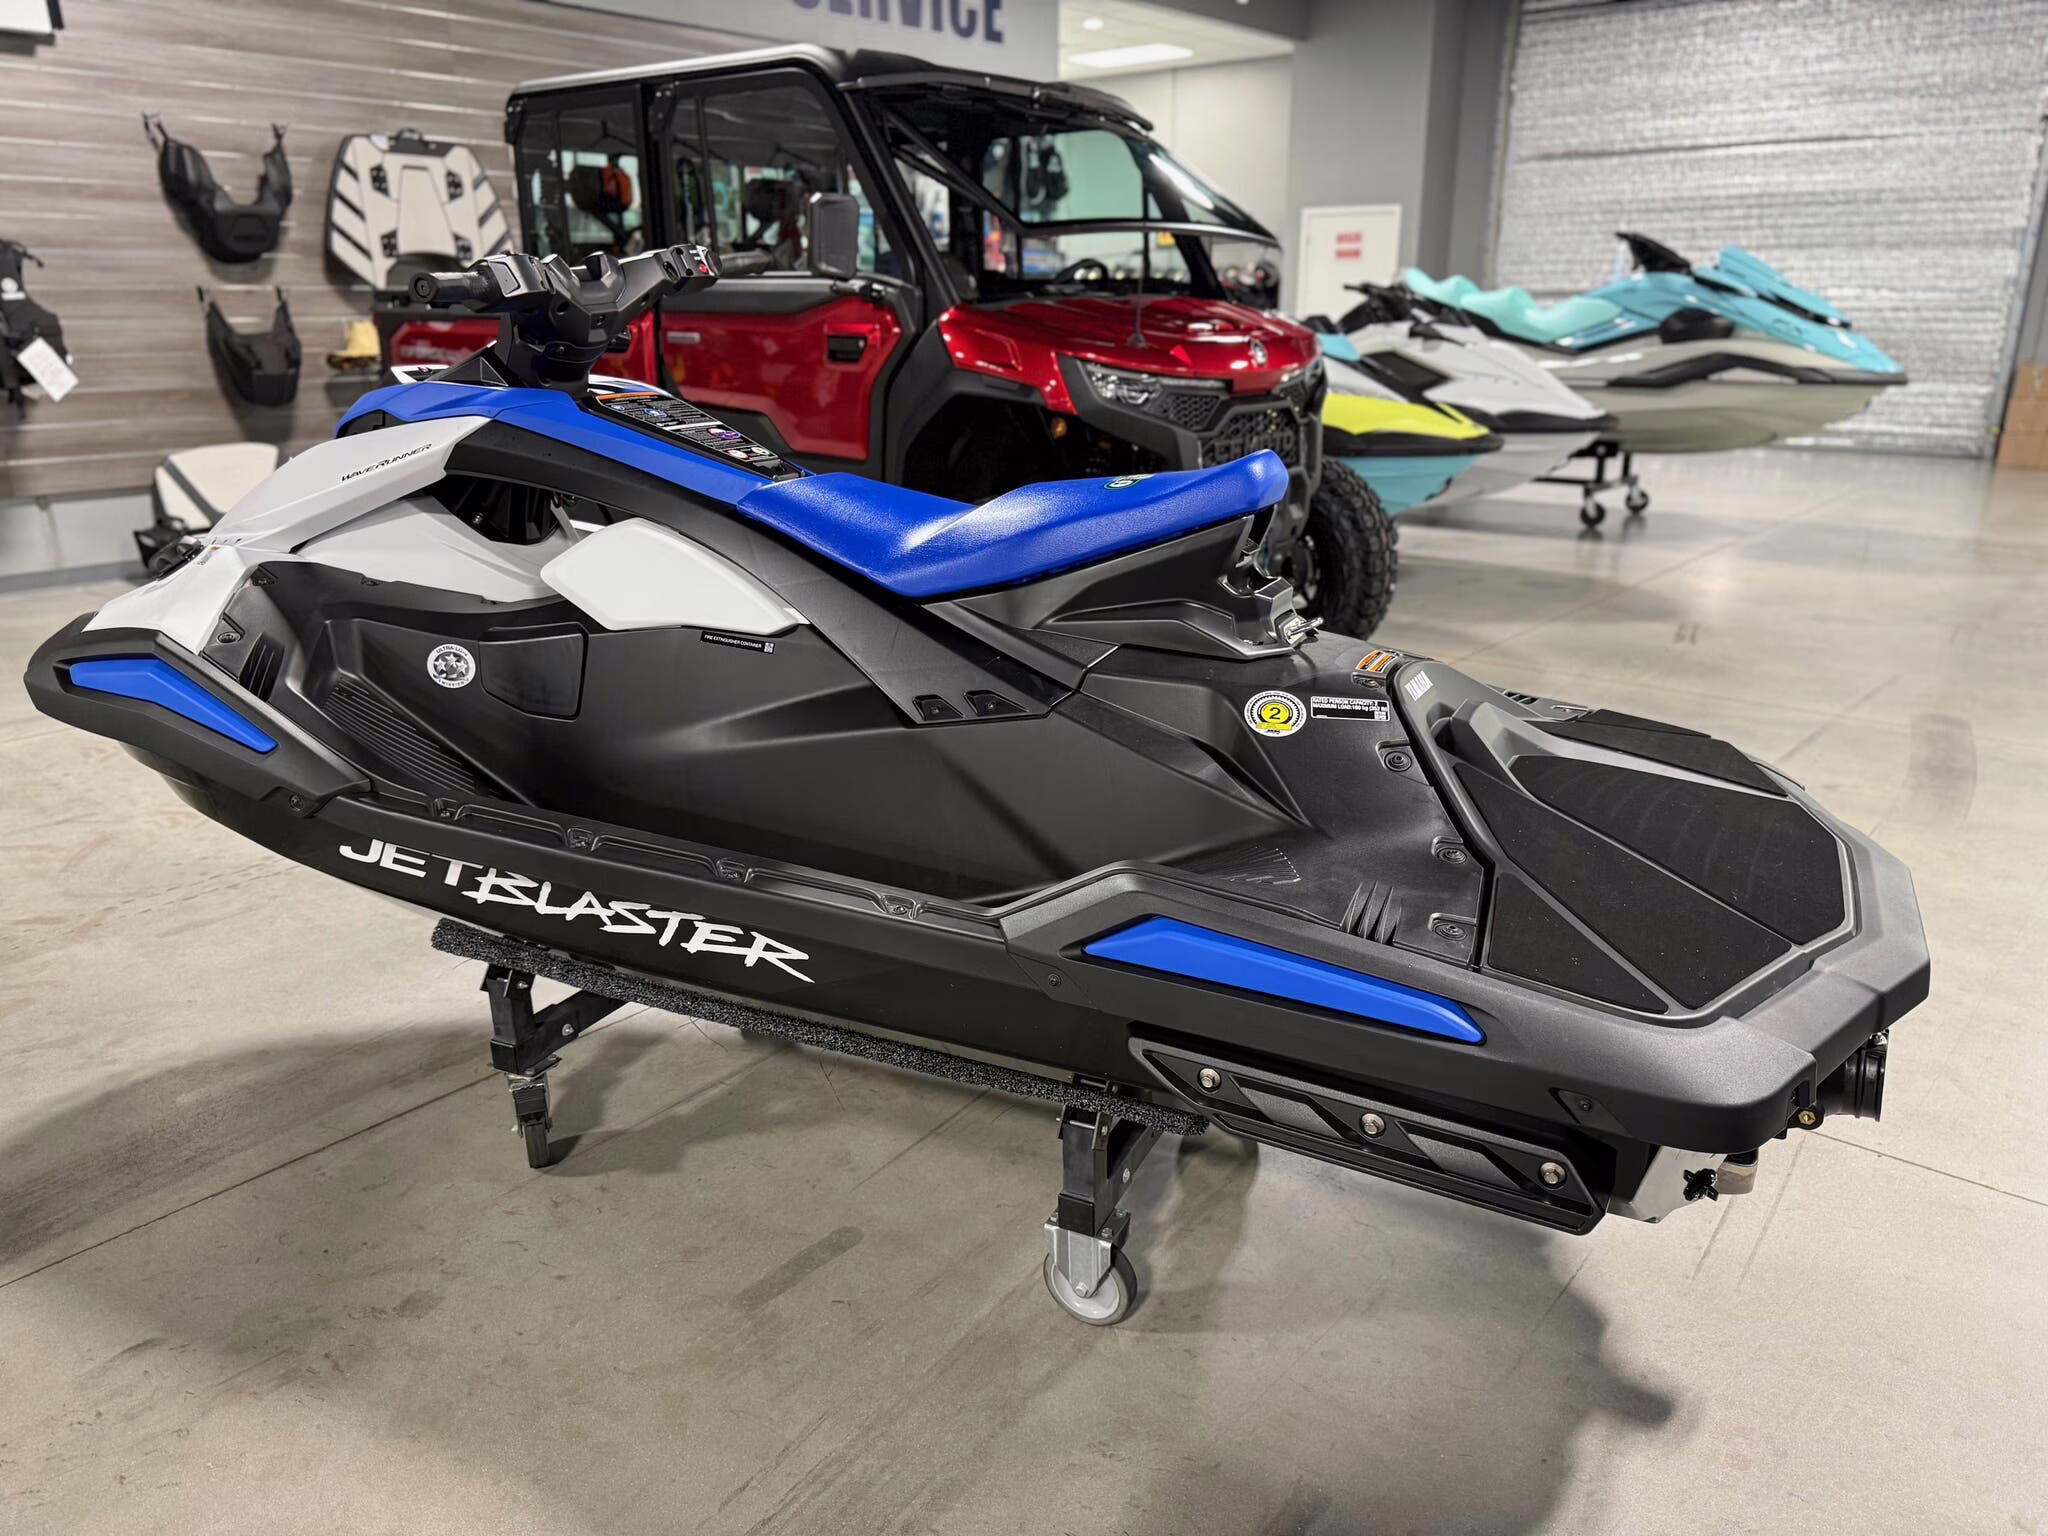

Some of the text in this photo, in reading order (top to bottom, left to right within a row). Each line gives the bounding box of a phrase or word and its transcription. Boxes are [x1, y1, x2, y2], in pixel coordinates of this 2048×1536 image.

[341, 443, 432, 482] WAVERUNNER
[740, 640, 762, 649] CONTAINER
[1269, 707, 1281, 720] 2
